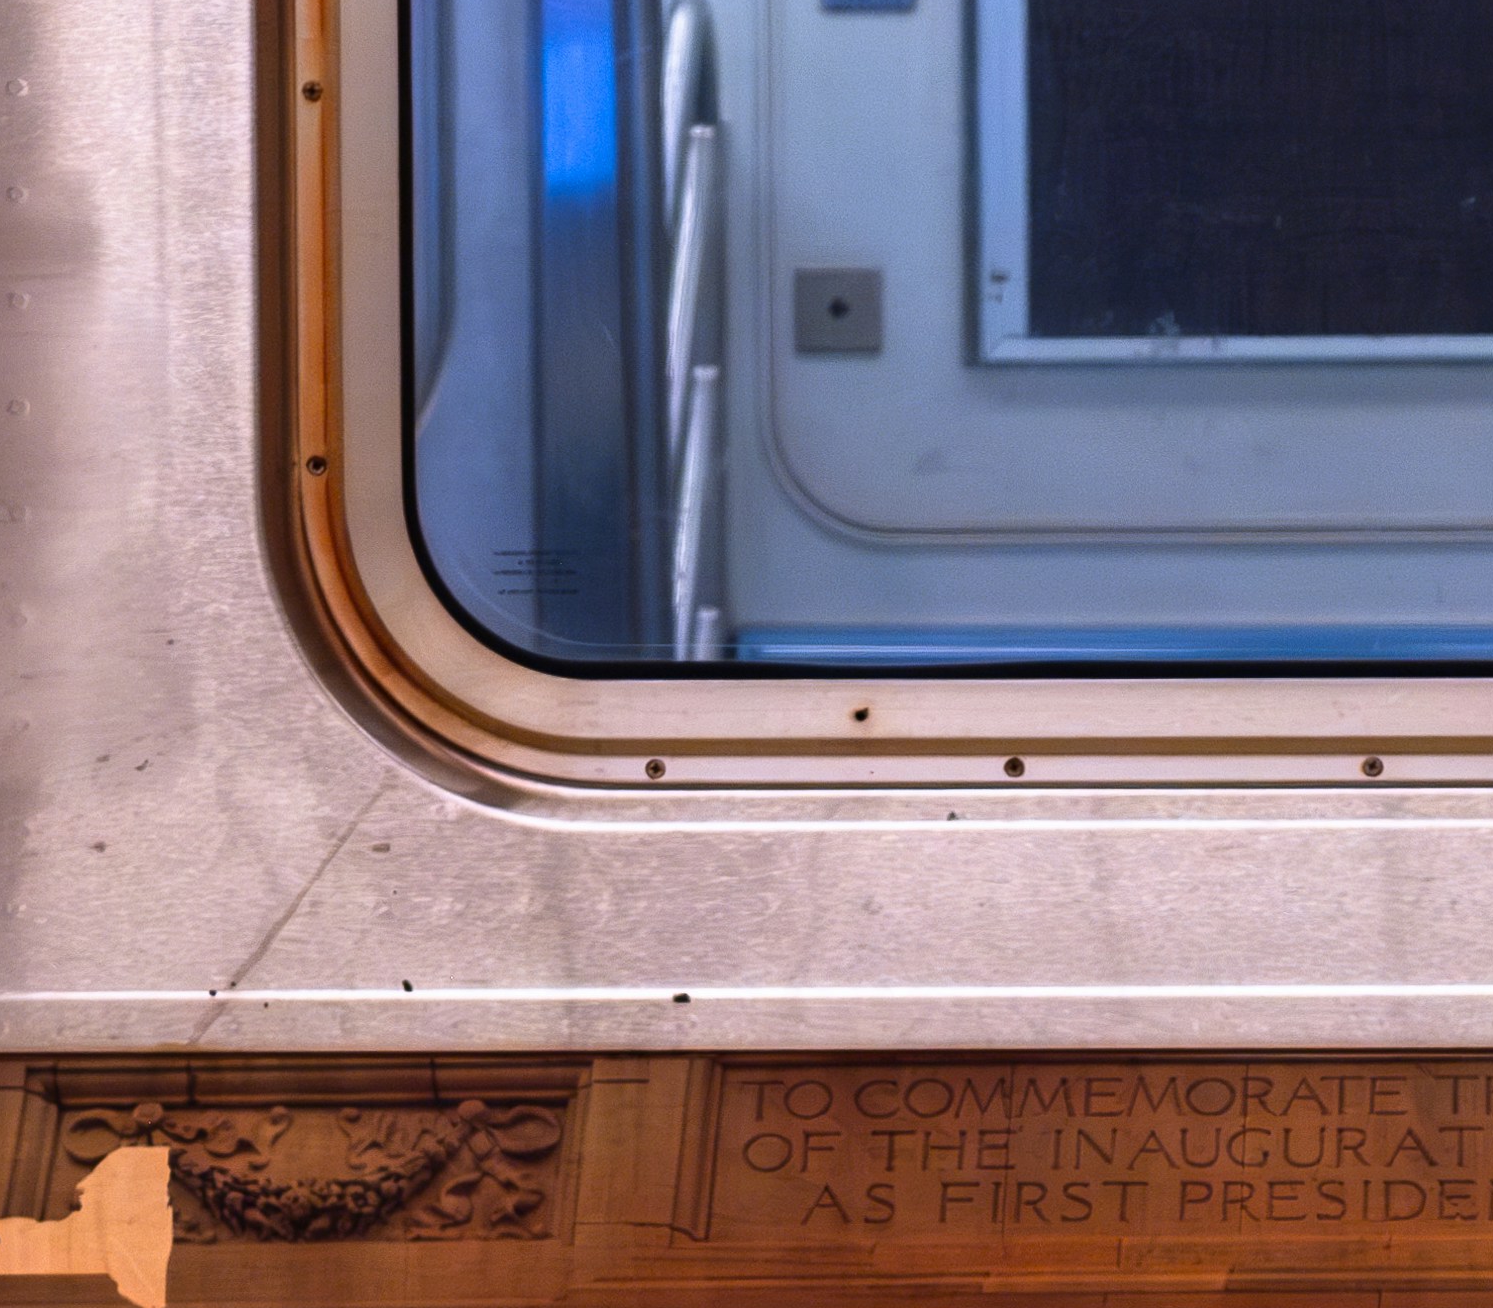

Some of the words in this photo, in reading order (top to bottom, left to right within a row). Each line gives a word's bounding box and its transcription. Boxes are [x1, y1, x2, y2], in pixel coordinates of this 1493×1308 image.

[741, 1078, 835, 1122] TO
[853, 1075, 1407, 1119] COMMEMORATE
[742, 1130, 842, 1174] OF
[870, 1128, 1018, 1172] THE
[800, 1182, 897, 1226] AS
[937, 1179, 1150, 1225] FIRST
